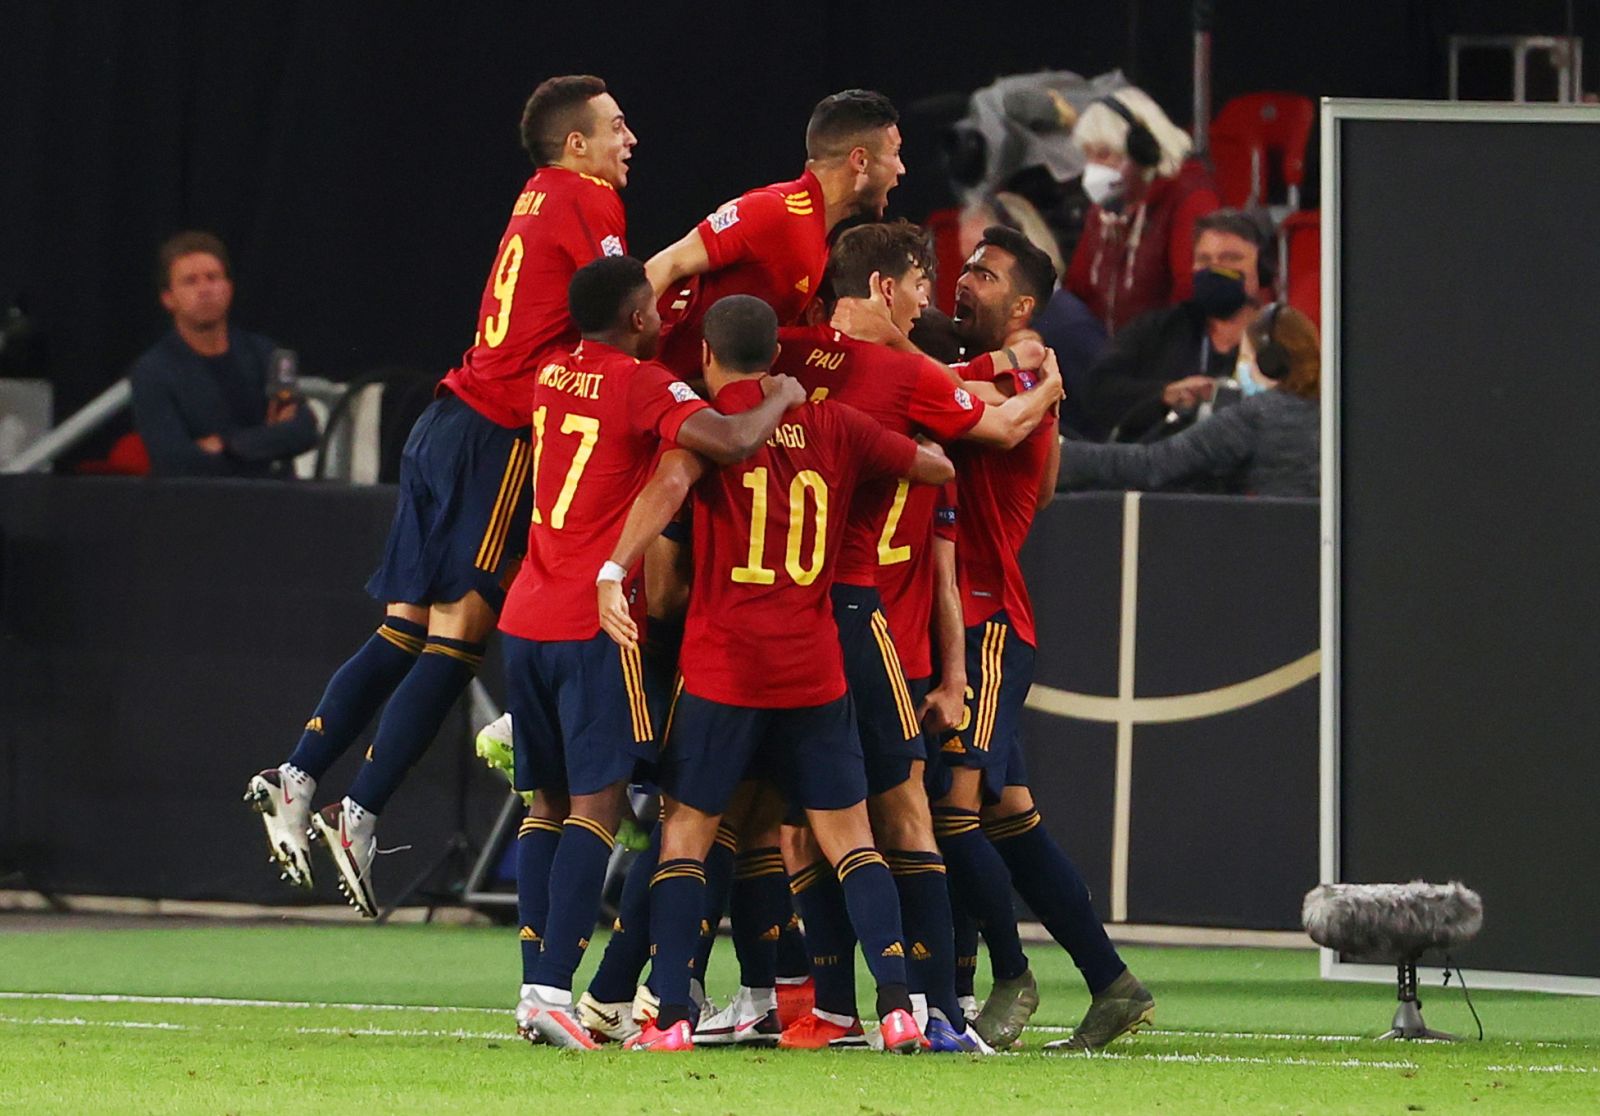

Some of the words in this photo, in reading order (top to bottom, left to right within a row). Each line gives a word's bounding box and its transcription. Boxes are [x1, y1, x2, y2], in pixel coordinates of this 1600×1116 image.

[474, 233, 524, 348] 9
[805, 348, 846, 370] PAU
[531, 405, 600, 529] 17
[766, 423, 806, 449] AGO
[731, 466, 828, 586] 10
